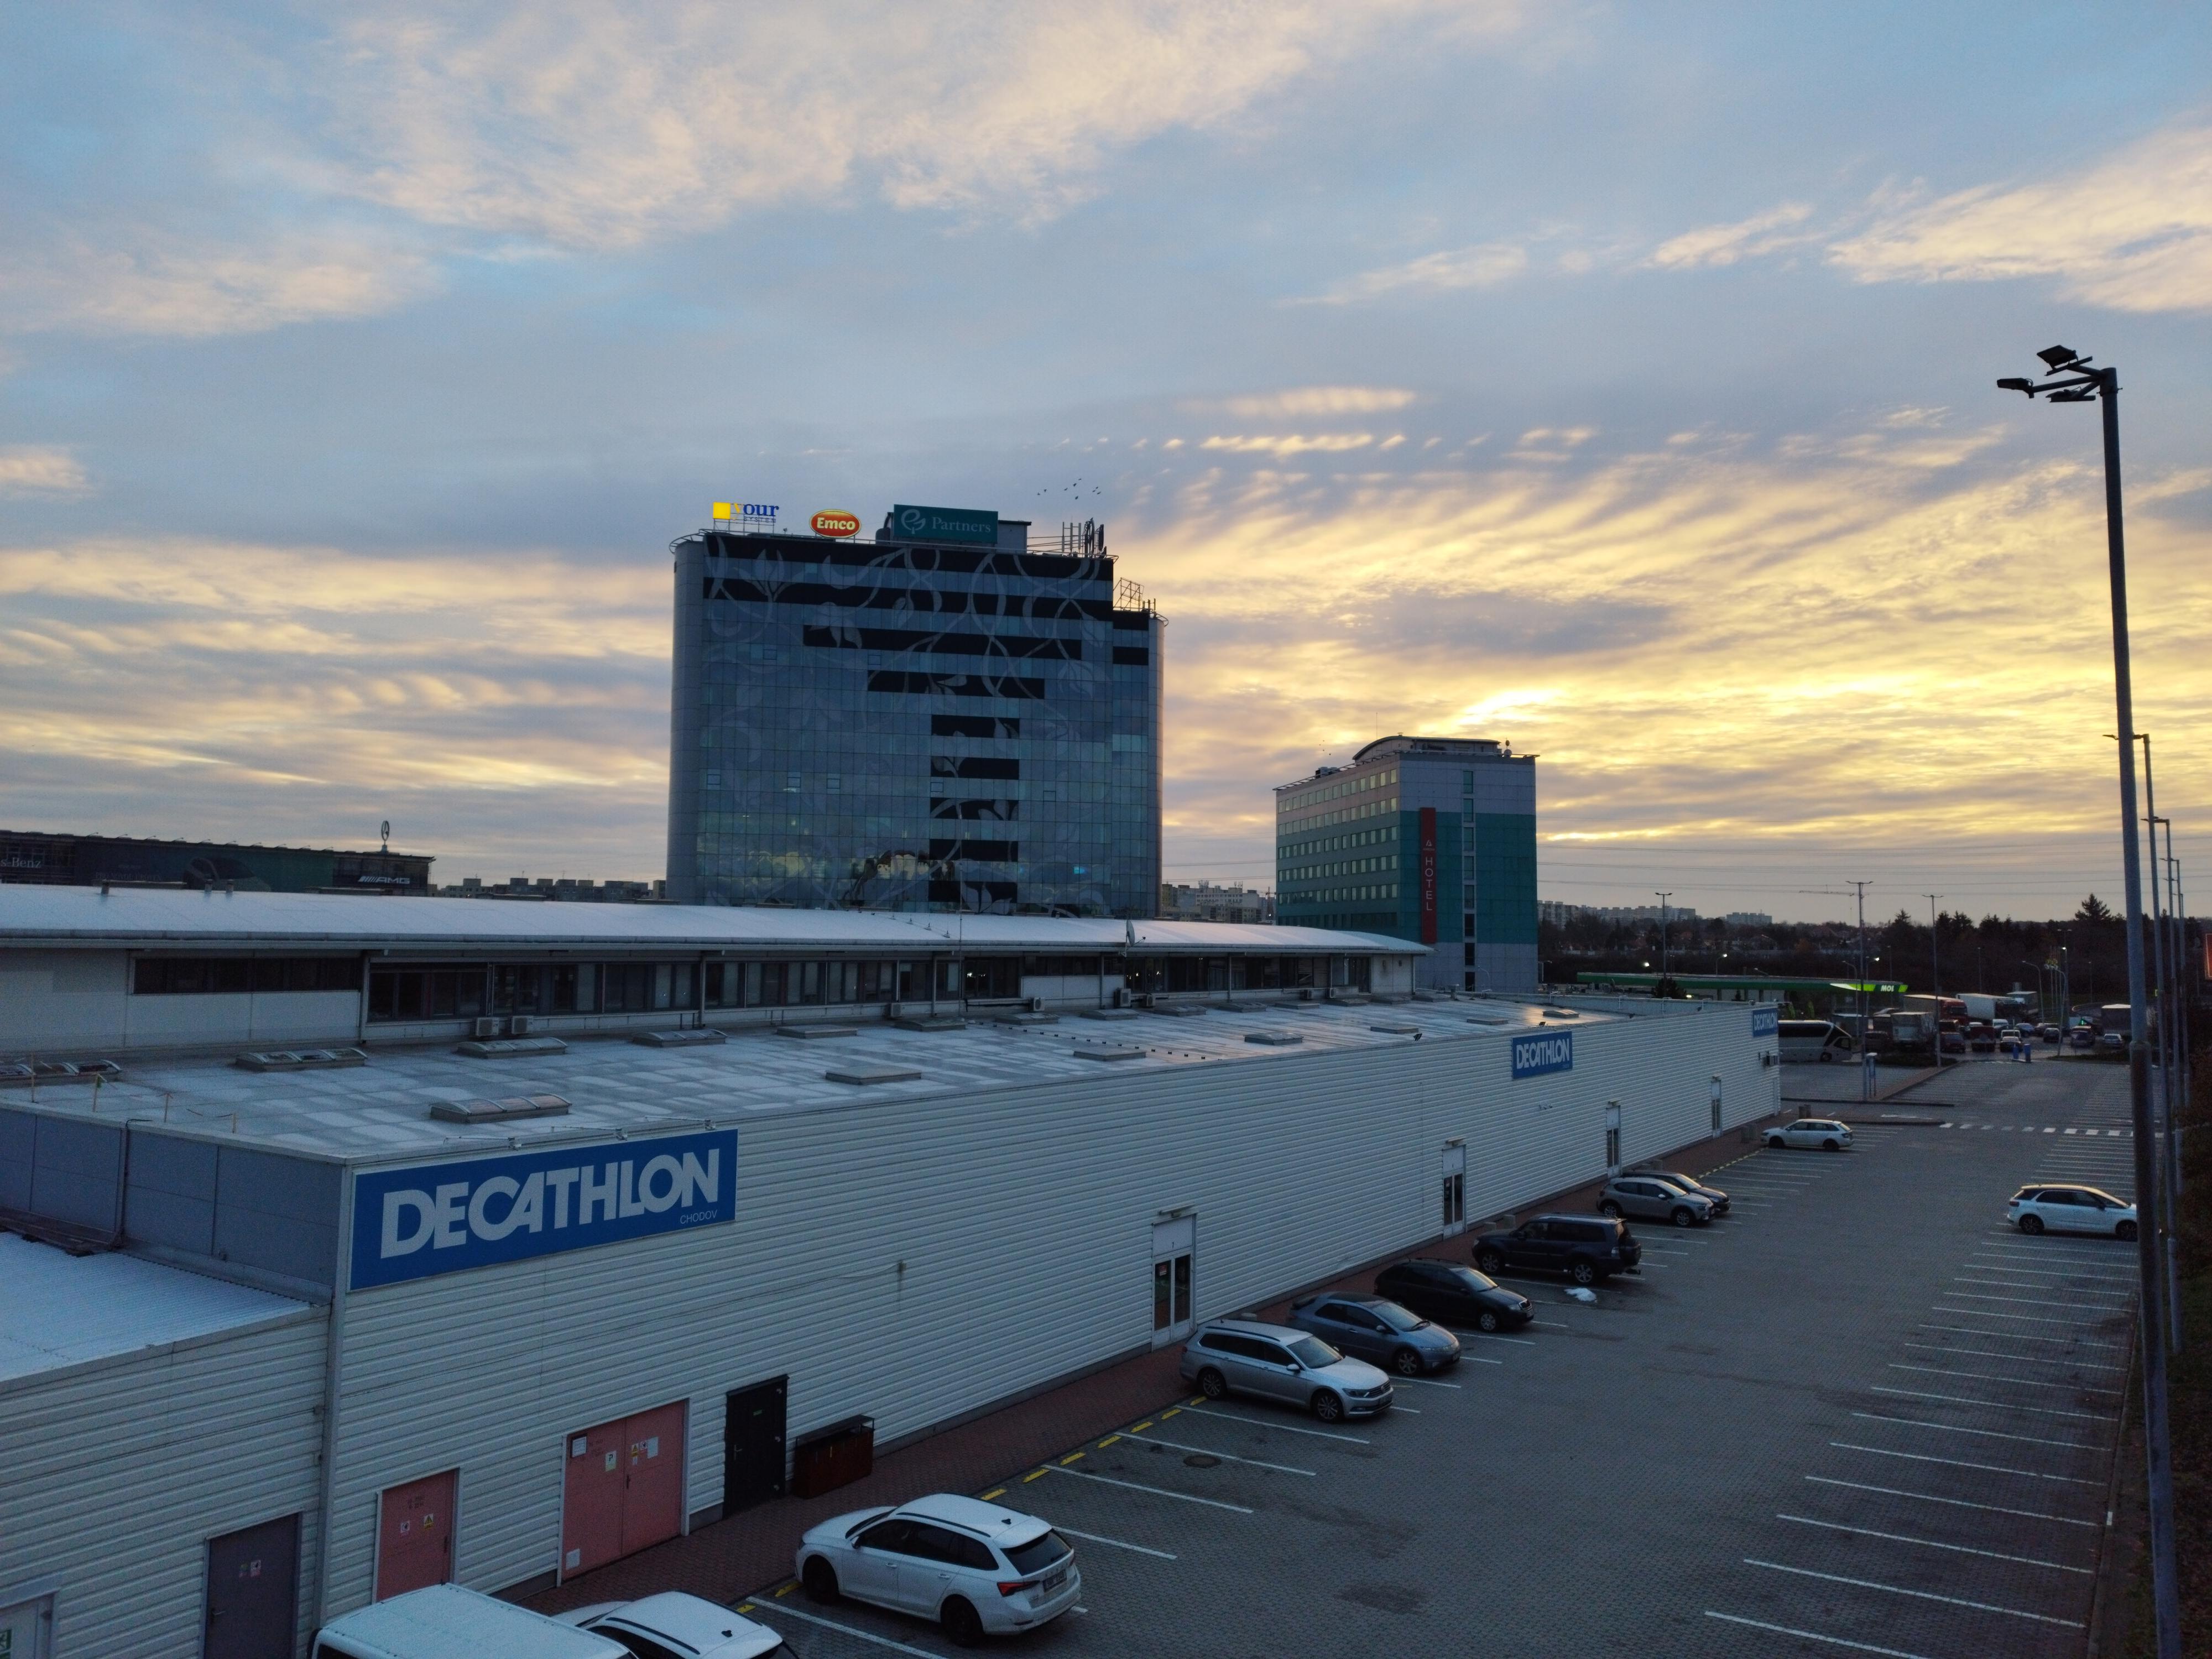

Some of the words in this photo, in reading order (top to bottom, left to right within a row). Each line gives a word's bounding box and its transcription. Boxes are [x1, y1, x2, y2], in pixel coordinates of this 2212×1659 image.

[732, 503, 779, 521] your
[817, 517, 855, 530] Emco
[932, 517, 991, 533] Partners
[1425, 857, 1433, 911] HOTEL
[1754, 1013, 1777, 1031] DECATHLON
[1516, 1039, 1569, 1070] DECATHLON
[380, 1149, 719, 1259] DECATHLON
[680, 1209, 718, 1224] CHODOV
